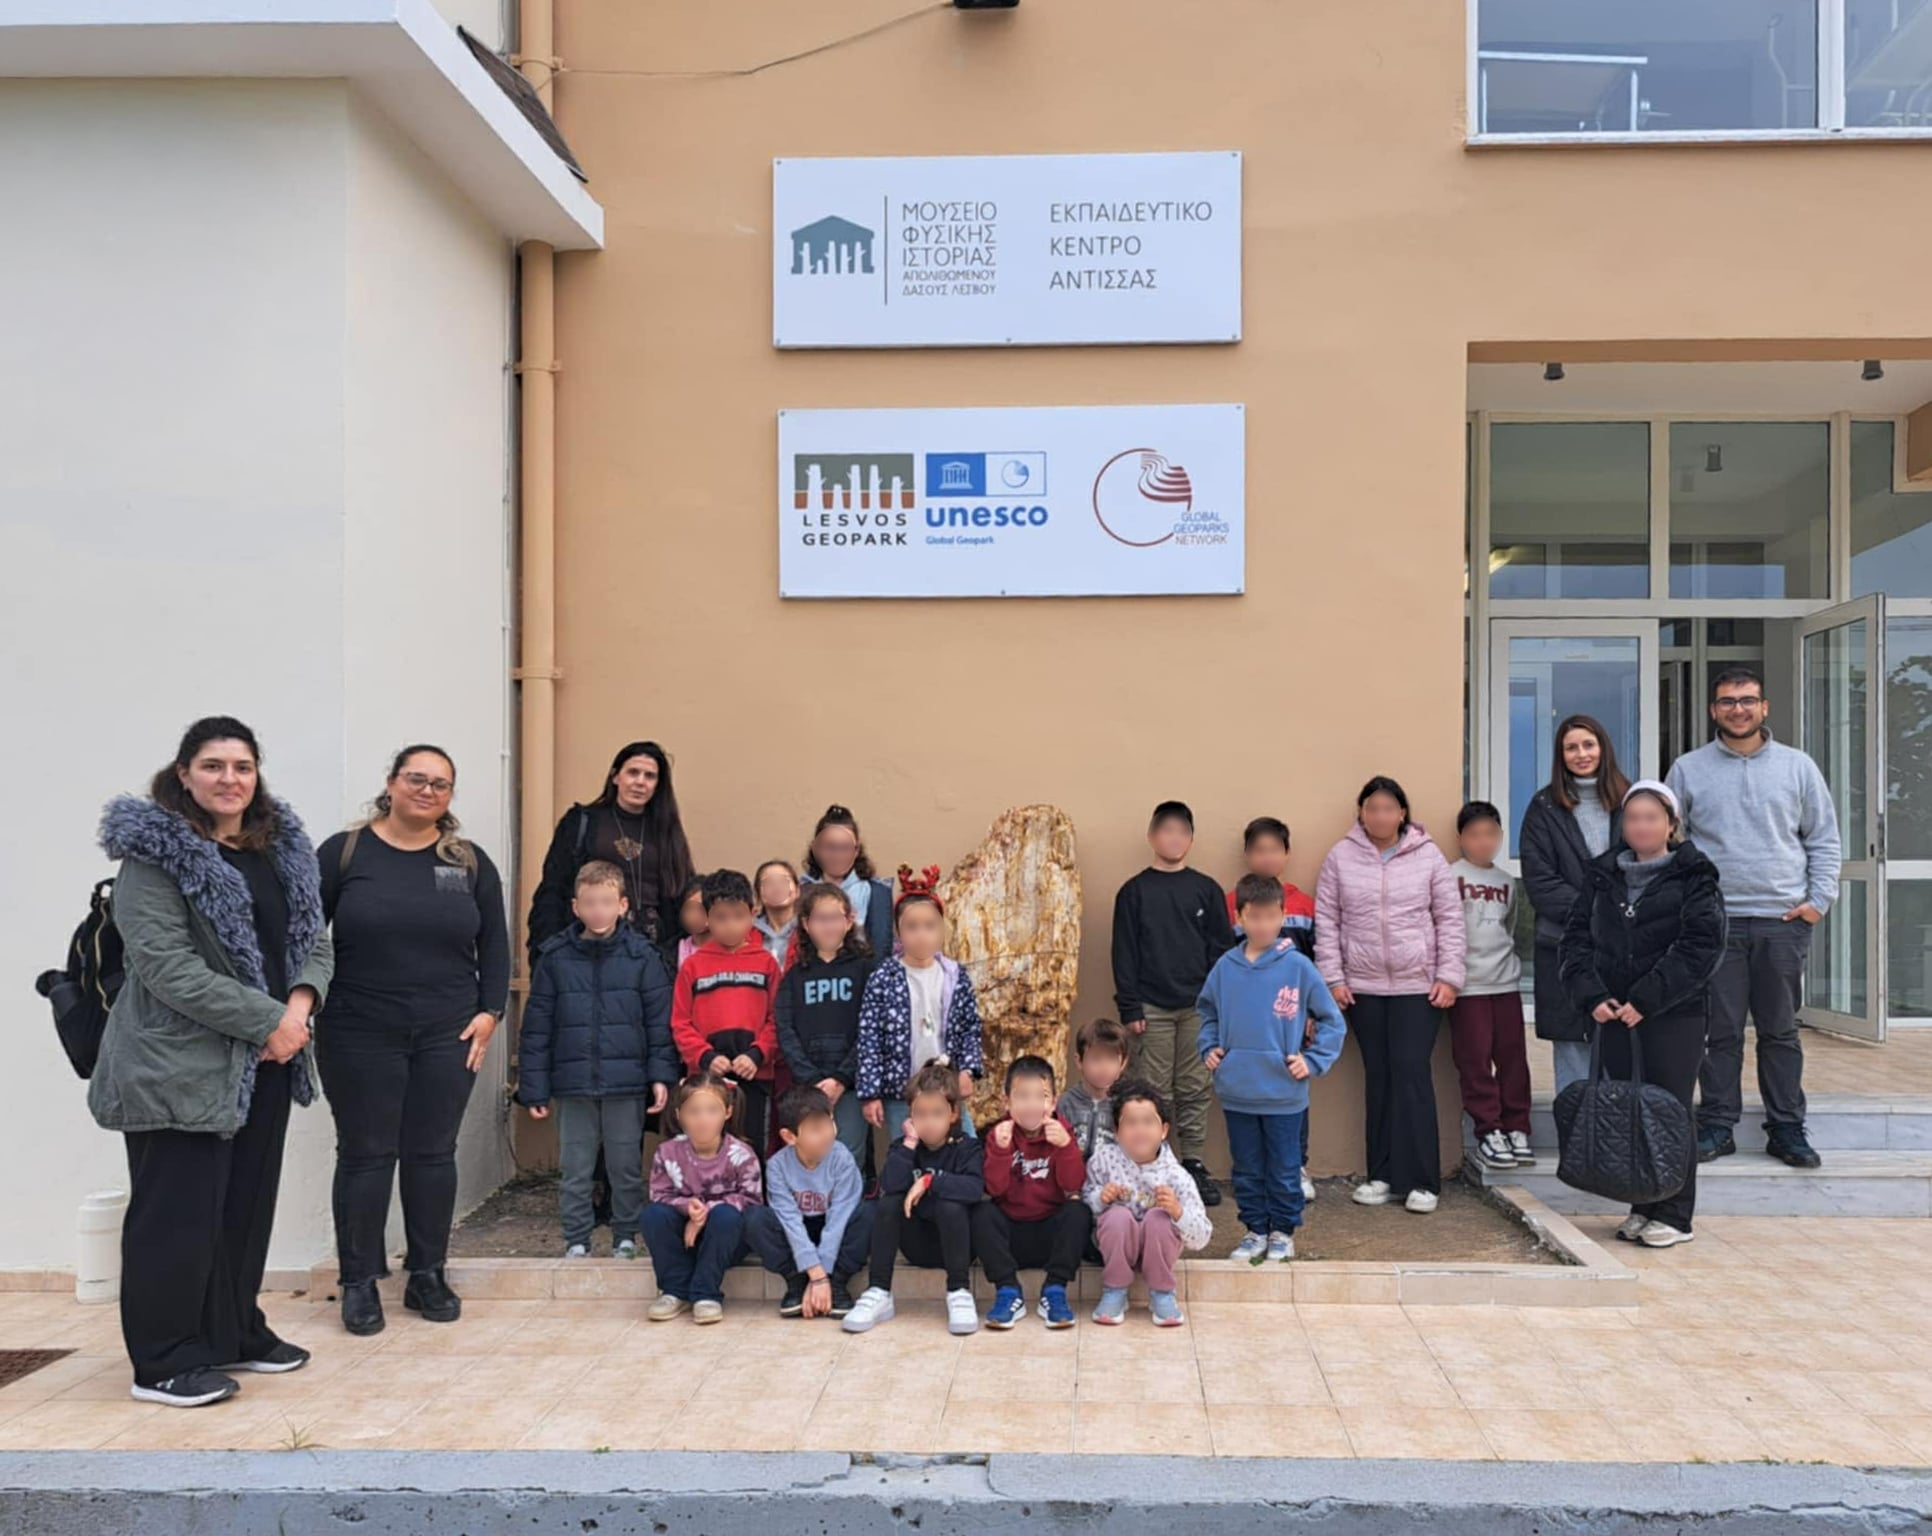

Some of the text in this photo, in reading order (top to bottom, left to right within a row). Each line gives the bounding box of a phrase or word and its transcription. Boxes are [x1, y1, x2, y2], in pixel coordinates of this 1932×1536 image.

[902, 201, 997, 221] ΜΟΥΣΕΙΟ
[1050, 201, 1212, 223] ΕΚΠΑΙΔΕΥΤΙΚΟ
[902, 224, 997, 244] ΦΥΣΙΚΗΣ
[1050, 235, 1142, 256] ΚΕΝΤΡΟ
[903, 246, 997, 267] ΙΣΤΟΡΙΑΣ
[1049, 269, 1157, 290] ΑΝΤΙΣΣΑΣ
[902, 284, 948, 296] ΔΑΣΟΥΣ
[803, 513, 907, 527] LESVOS
[926, 506, 1048, 527] unesco
[1181, 511, 1221, 522] GLOBAL
[1173, 522, 1230, 533] GEOPARKS
[802, 532, 907, 546] GEOPARK
[925, 535, 995, 548] Global Geopark
[1175, 534, 1227, 545] NETWORK
[804, 977, 853, 1004] EPIC
